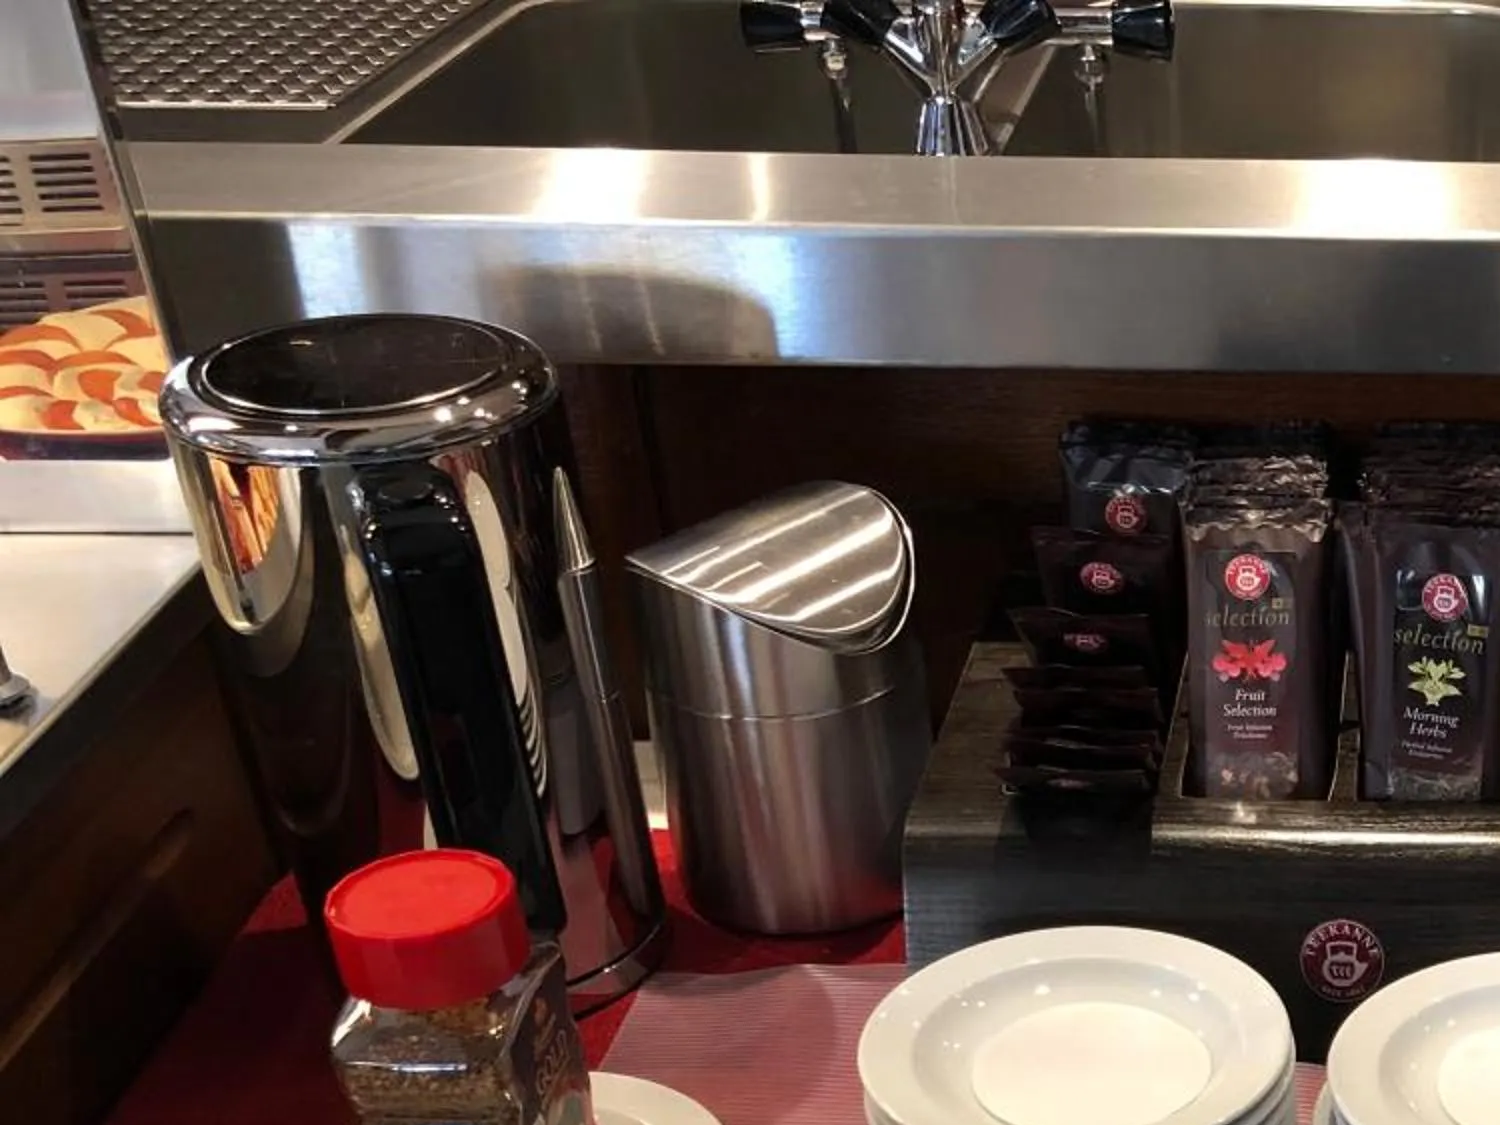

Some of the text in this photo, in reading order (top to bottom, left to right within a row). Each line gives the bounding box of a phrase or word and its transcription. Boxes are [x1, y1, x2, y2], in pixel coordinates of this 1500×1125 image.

[1394, 624, 1484, 655] selection
[1235, 688, 1266, 701] Fruit
[1223, 703, 1277, 718] Selection
[1403, 705, 1461, 729] Morning
[1409, 722, 1448, 739] Herbs
